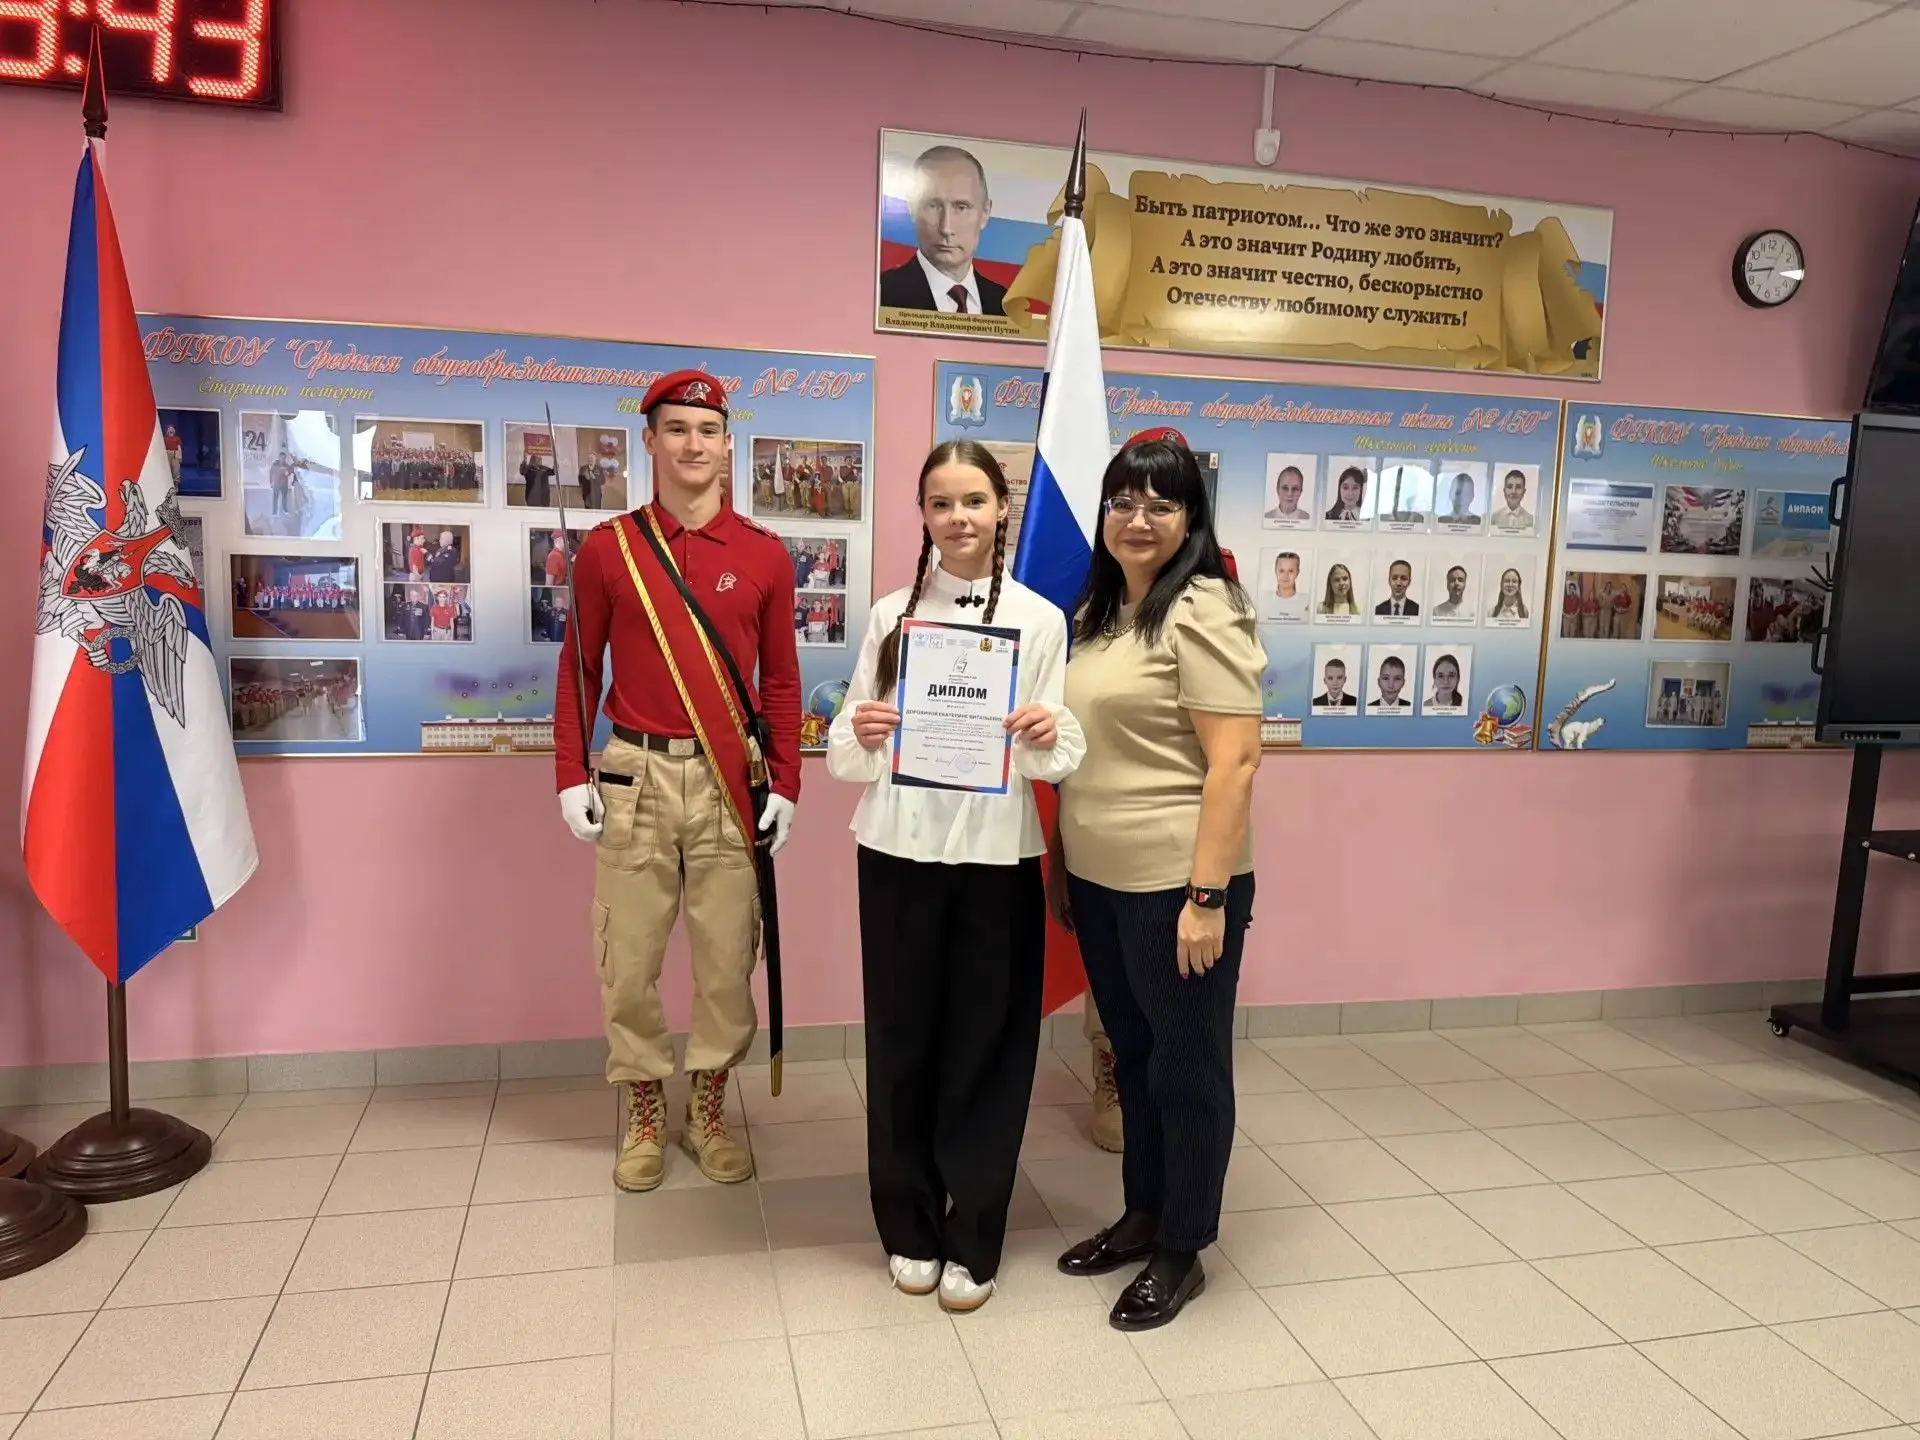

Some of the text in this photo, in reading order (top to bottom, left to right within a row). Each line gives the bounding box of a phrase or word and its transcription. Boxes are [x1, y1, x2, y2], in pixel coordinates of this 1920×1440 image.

[1135, 195, 1504, 248] Быть патриотом... Что же это значит?
[1181, 229, 1461, 275] А это значит Родину любить,
[1150, 256, 1484, 301] А это значит честно, бескорыстно
[885, 317, 1020, 335] Владимир Владимирович Путин
[1167, 286, 1468, 327] Отечеству любимому служить!
[412, 345, 663, 389] общеобразовательная
[1200, 392, 1394, 430] общеобразовательная
[1400, 403, 1455, 430] школа
[1787, 504, 1824, 515] ДИПЛОМ
[927, 684, 987, 699] ДИПЛОМ
